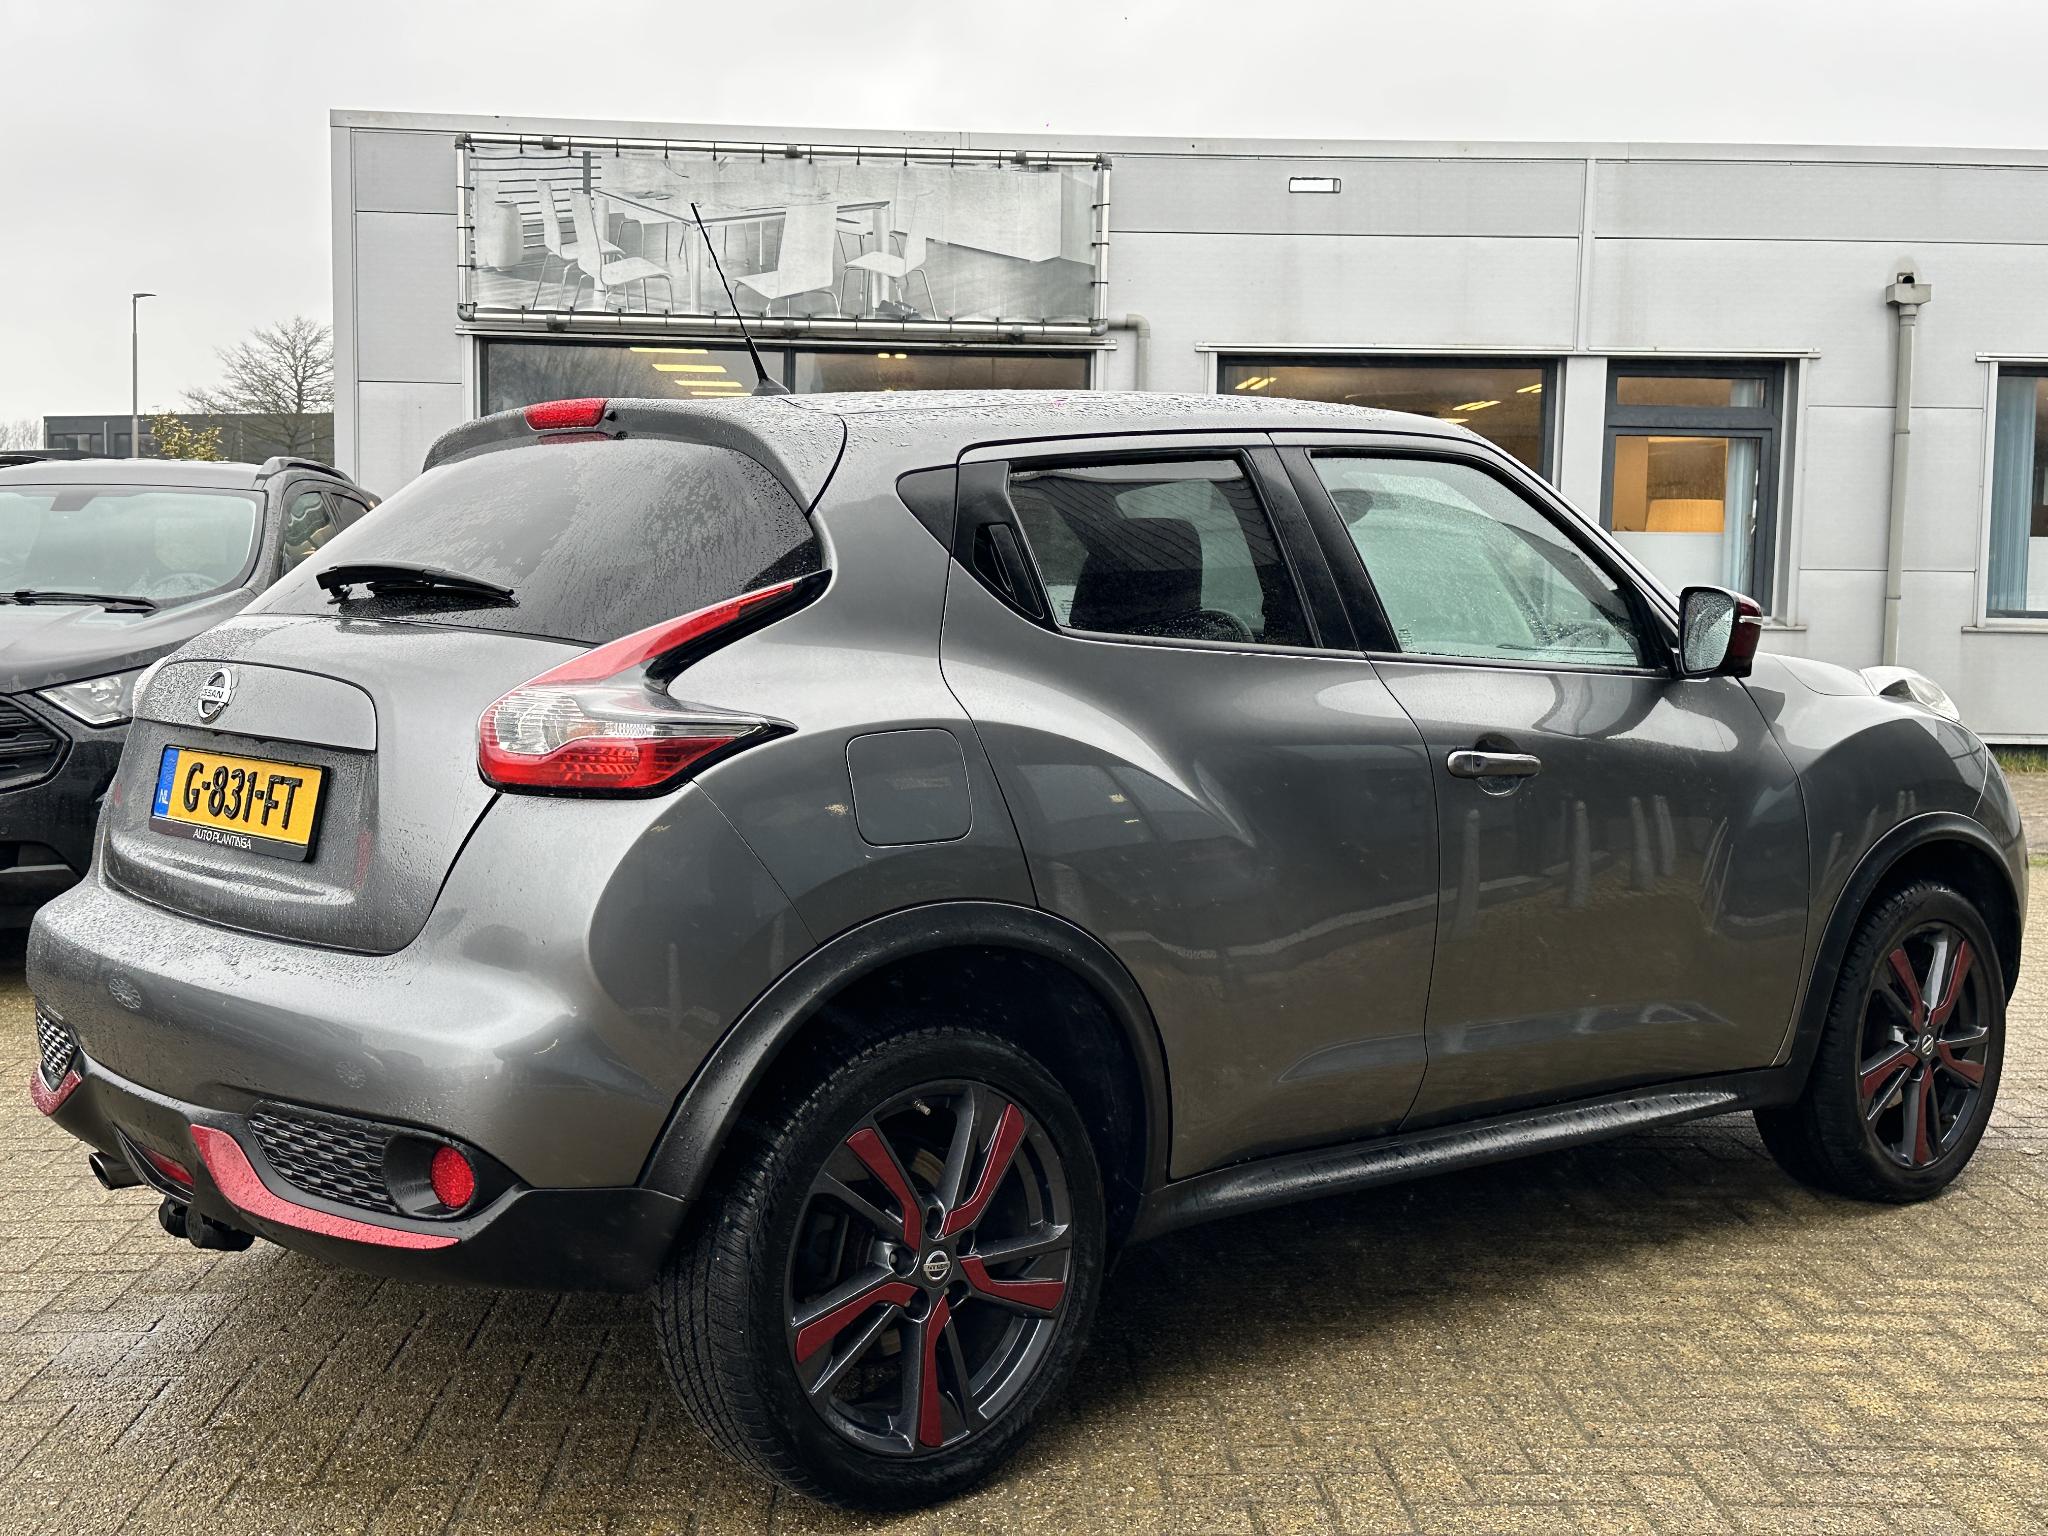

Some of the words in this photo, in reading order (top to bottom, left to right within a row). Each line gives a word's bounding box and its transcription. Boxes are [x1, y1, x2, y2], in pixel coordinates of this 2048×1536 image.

[158, 788, 169, 805] NL
[183, 762, 303, 830] G-831-FT
[193, 828, 213, 842] AUTO
